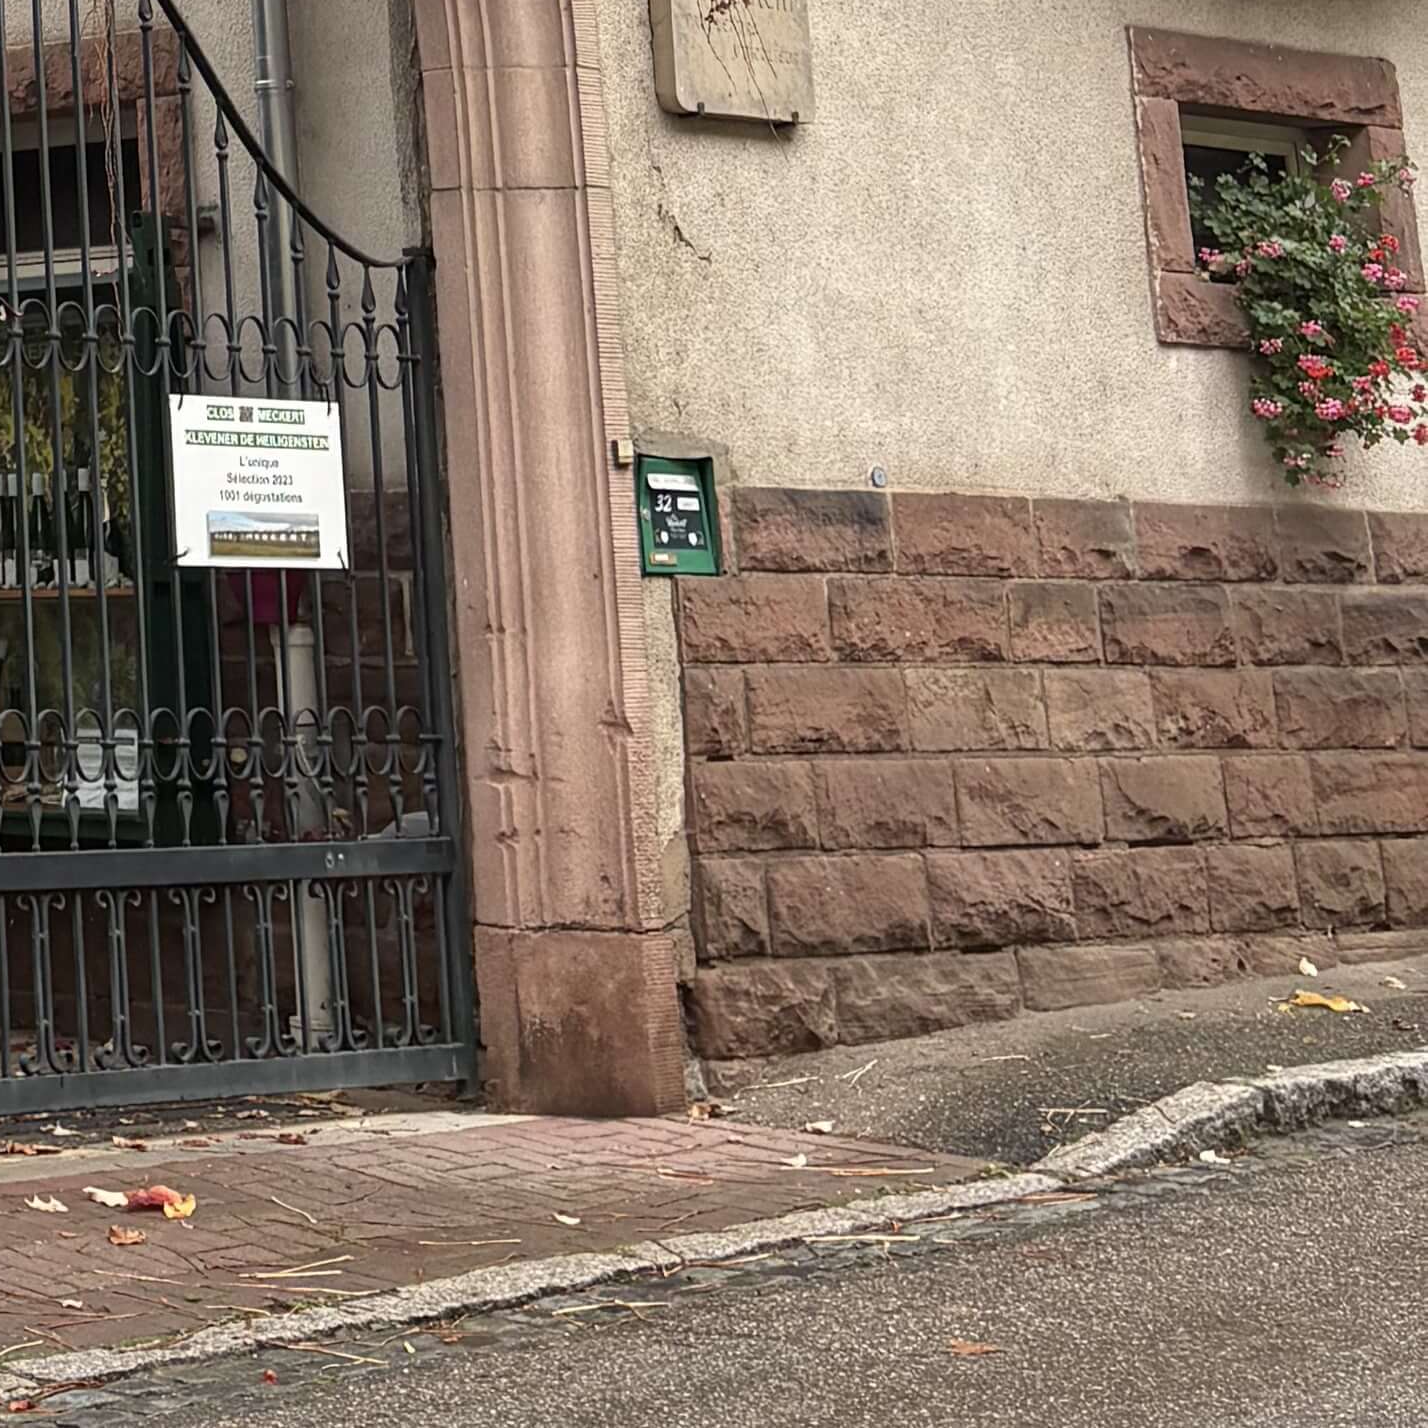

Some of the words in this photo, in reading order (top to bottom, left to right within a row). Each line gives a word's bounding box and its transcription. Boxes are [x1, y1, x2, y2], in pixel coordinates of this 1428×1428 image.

[207, 404, 235, 422] CLOS
[185, 430, 239, 446] KLEVENER
[240, 434, 255, 447] DE
[654, 493, 672, 512] 32
